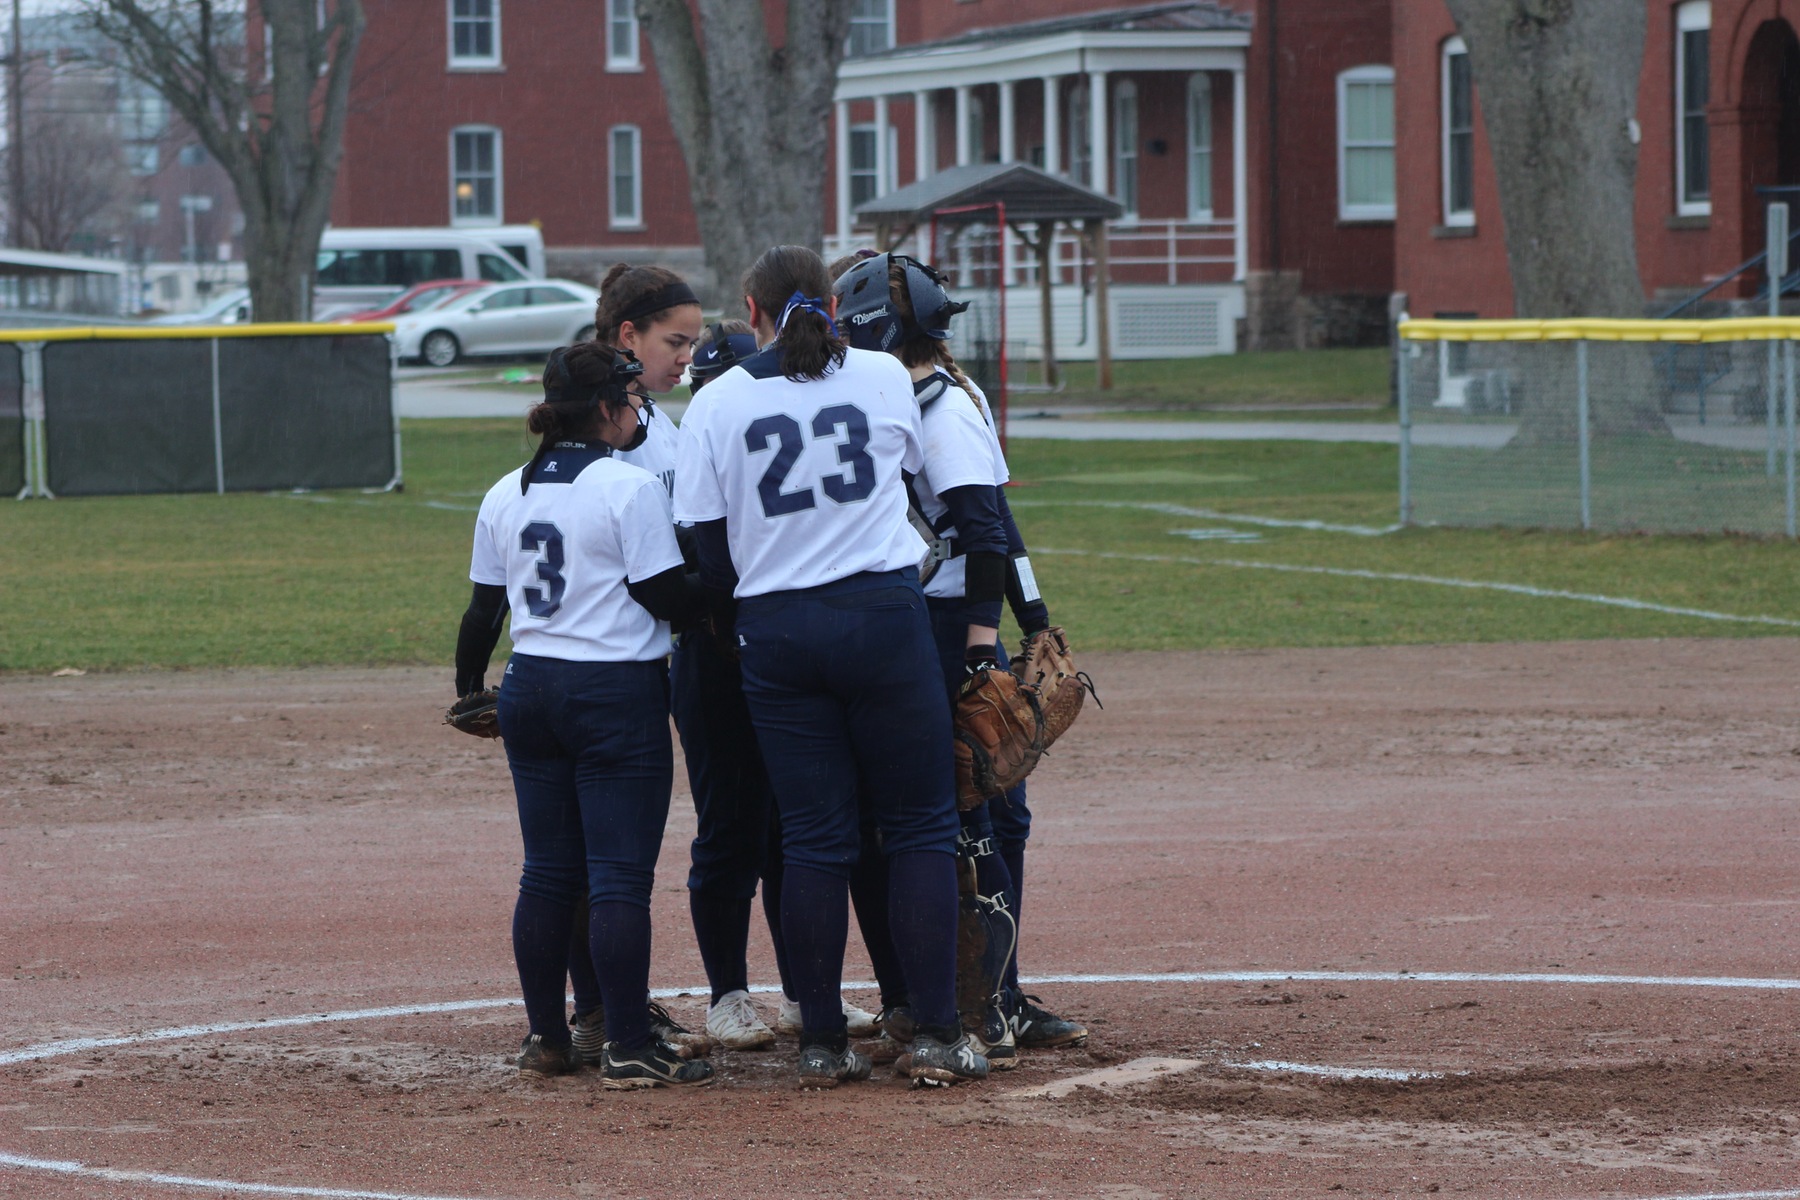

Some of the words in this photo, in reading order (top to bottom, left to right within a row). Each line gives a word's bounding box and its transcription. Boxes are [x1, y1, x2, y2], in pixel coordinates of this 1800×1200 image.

[852, 304, 889, 326] Diamond
[744, 402, 878, 519] 23
[518, 520, 567, 621] 3
